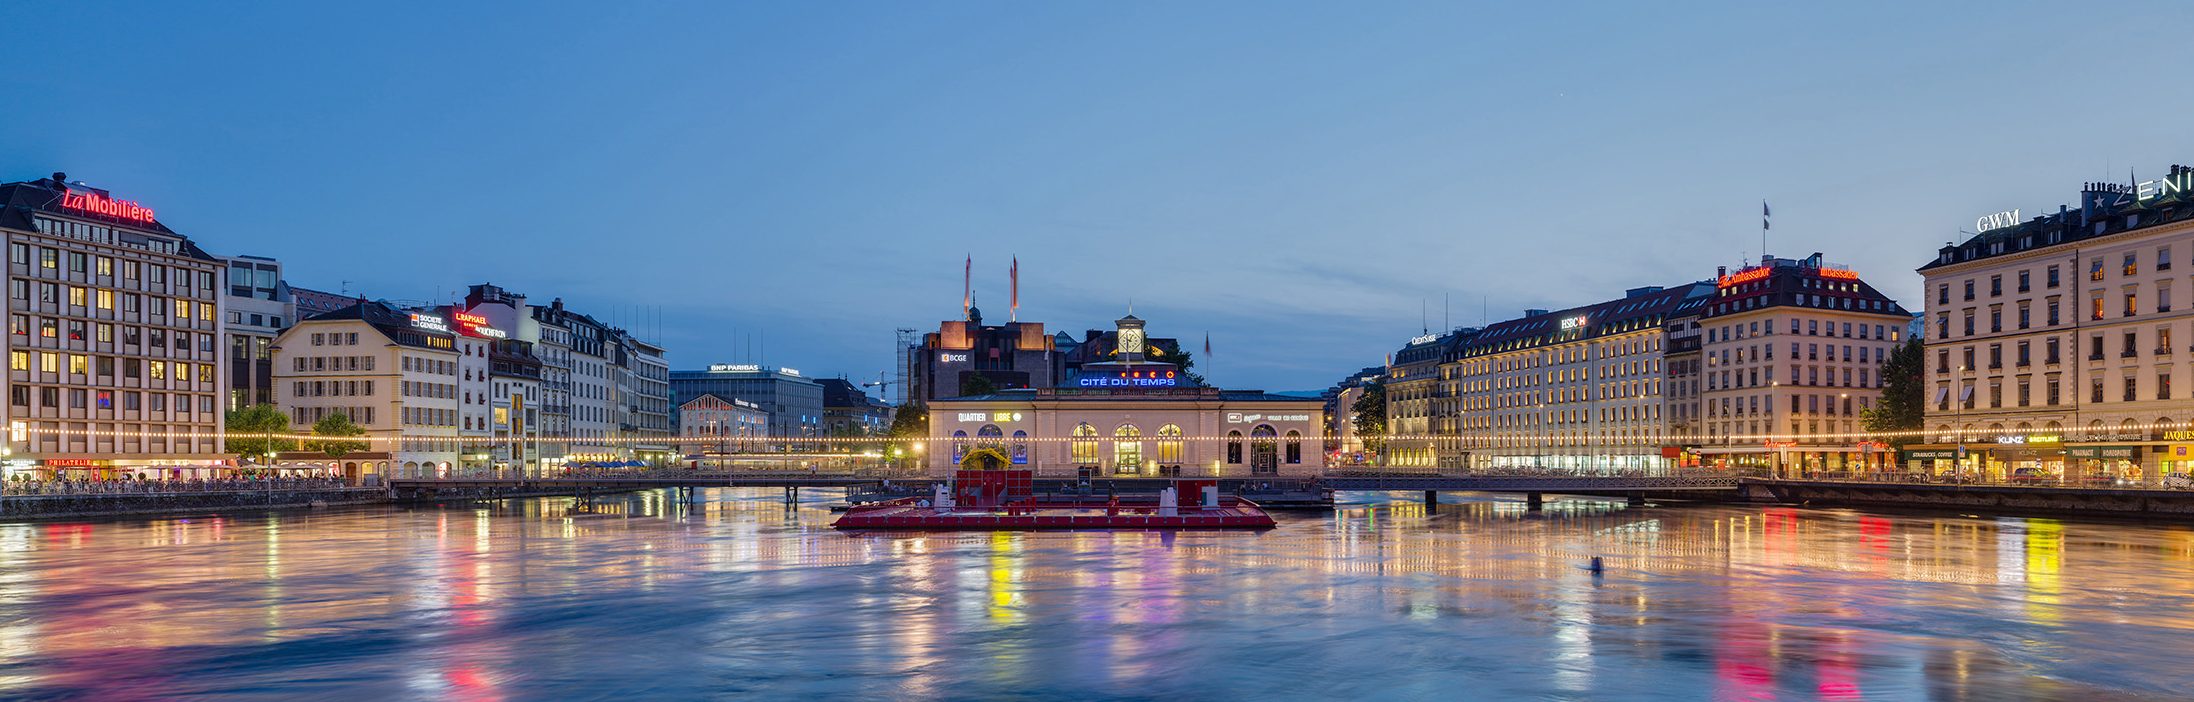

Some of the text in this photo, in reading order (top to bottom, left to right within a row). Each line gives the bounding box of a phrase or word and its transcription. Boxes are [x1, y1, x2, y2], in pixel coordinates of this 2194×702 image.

[63, 188, 154, 222] La Mobilière
[1976, 208, 2020, 233] GWM
[1731, 267, 1771, 284] Ambassador
[1820, 267, 1859, 280] mbassador
[1561, 317, 1579, 329] HSBC
[949, 354, 967, 362] BCGE
[1080, 377, 1107, 386] CITÉ
[1132, 378, 1175, 386] TEMPS
[958, 412, 1011, 422] QUARTIER LIBRE
[1998, 436, 2024, 444] KUNZ
